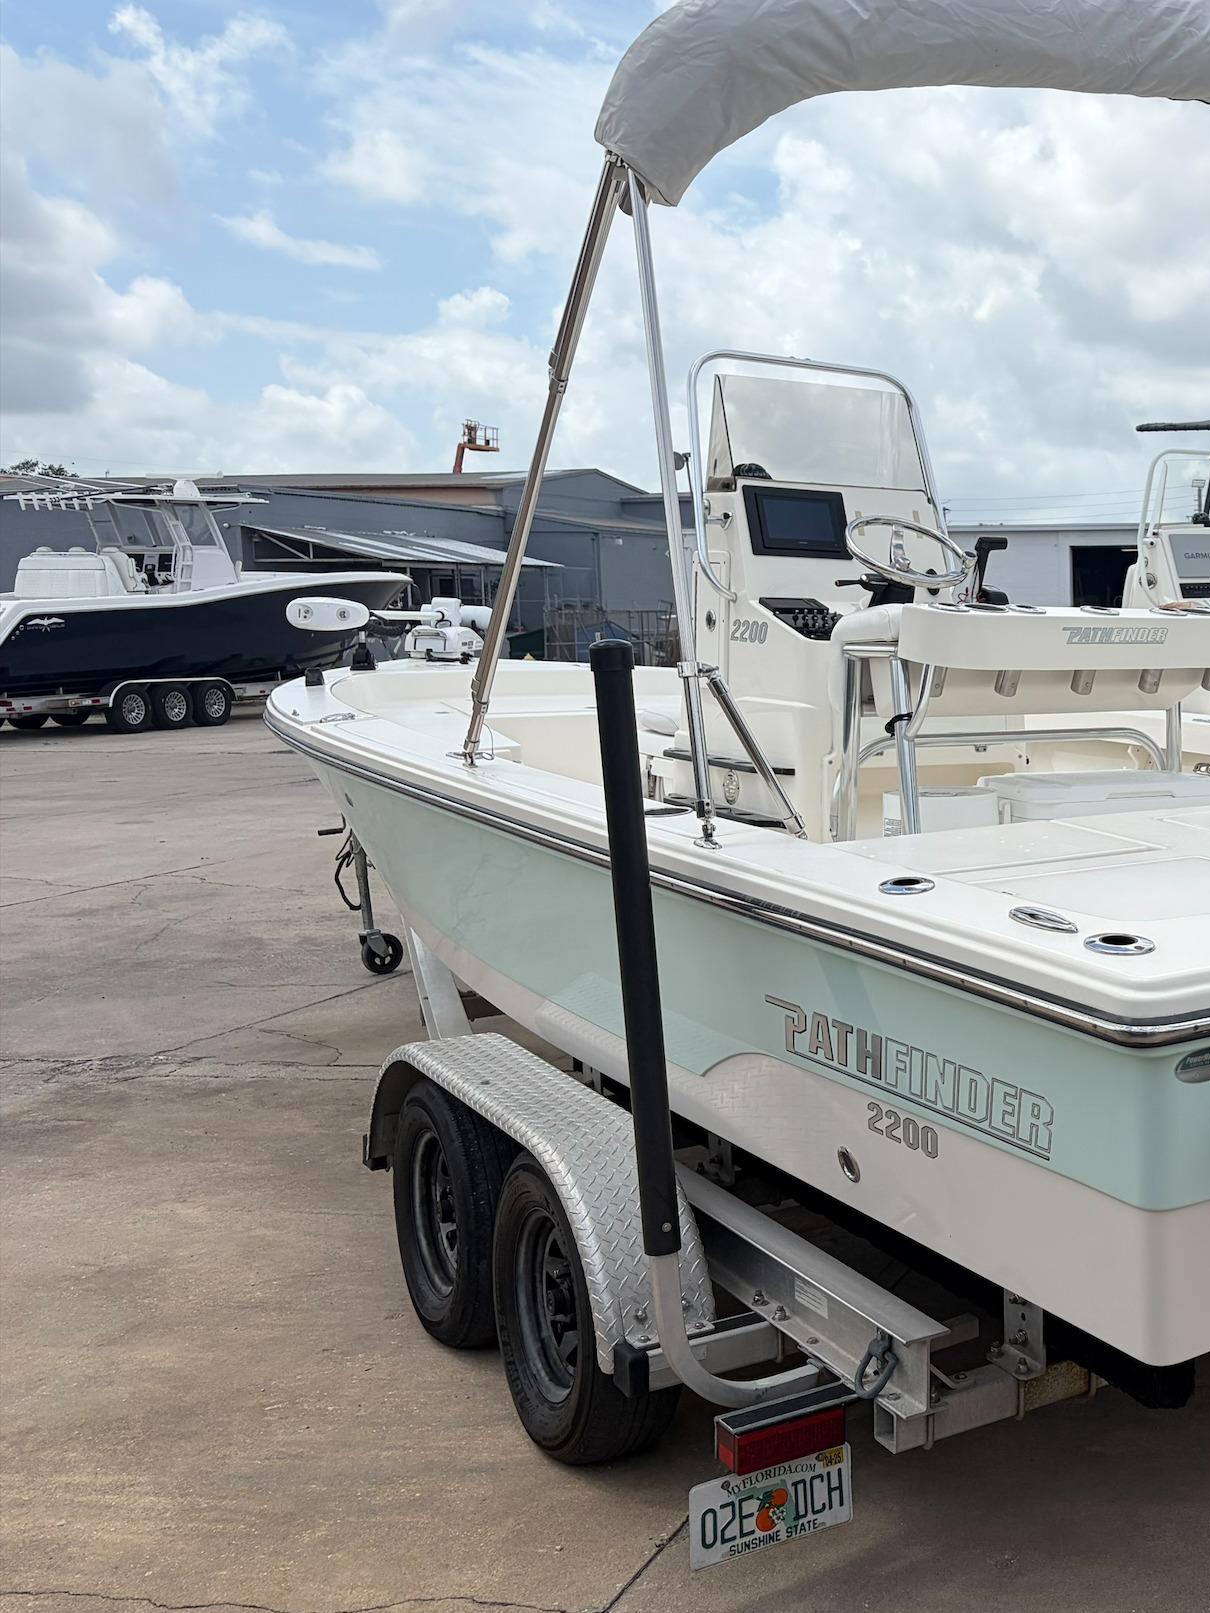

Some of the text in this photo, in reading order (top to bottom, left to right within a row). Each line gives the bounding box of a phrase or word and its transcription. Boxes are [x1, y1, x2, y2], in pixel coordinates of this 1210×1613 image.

[730, 618, 769, 645] 2200
[1062, 626, 1168, 645] PATHFINDER
[765, 994, 1054, 1157] PATHFINDER
[867, 1101, 939, 1159] 2200
[727, 1463, 816, 1498] MYFLORIDA.COM
[791, 1467, 844, 1522] DCH
[729, 1518, 818, 1557] SUNSHINE STATE
